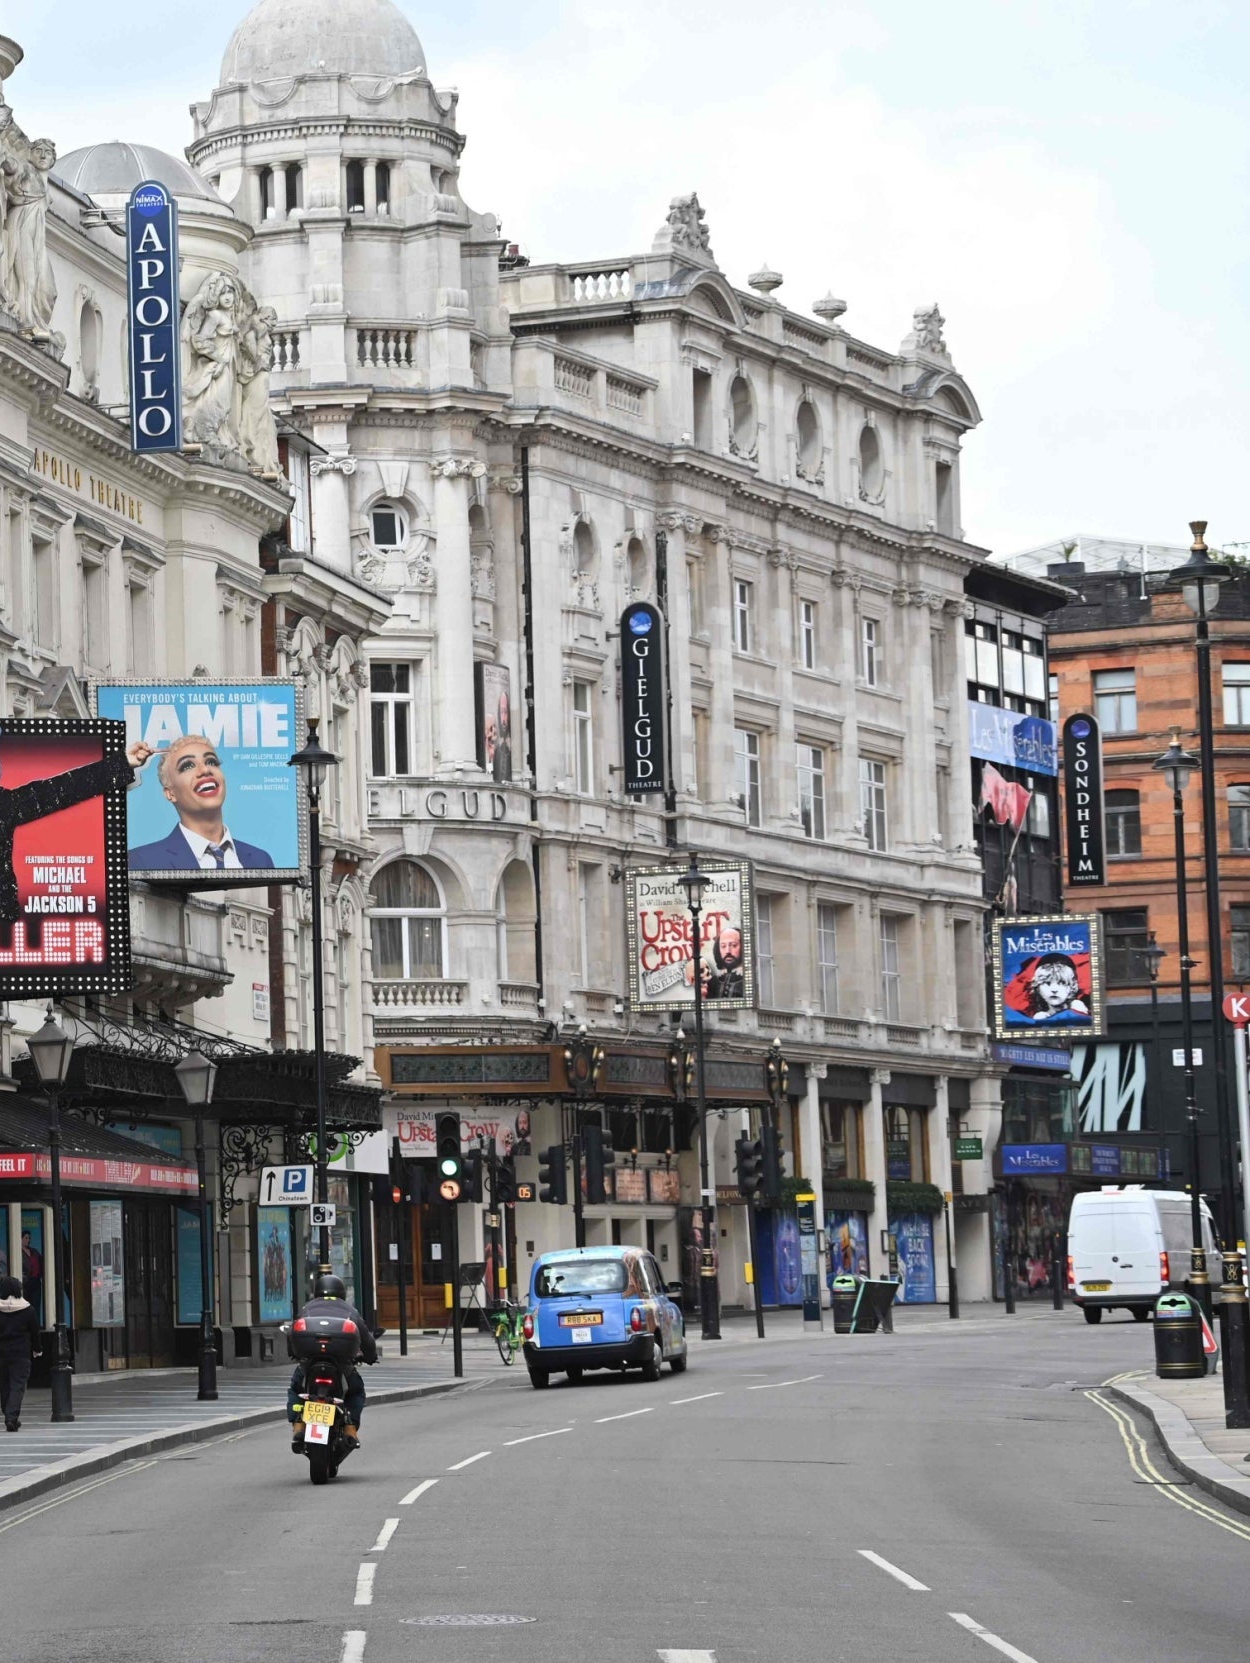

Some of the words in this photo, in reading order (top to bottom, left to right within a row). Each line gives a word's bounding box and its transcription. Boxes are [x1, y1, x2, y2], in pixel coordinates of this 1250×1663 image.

[136, 194, 163, 203] NIMAX
[136, 223, 172, 437] APOLLO
[34, 448, 81, 492] APOLLO
[90, 476, 142, 524] THEATRE
[123, 693, 185, 704] EVERYBODY'S
[187, 693, 225, 703] TALKING
[228, 692, 258, 703] ABOUT
[632, 638, 654, 778] GIELGUD
[972, 709, 992, 753] Les
[628, 781, 662, 789] THEATRE
[367, 790, 507, 820] ELGUD
[1074, 741, 1093, 871] SONDHEIM
[26, 856, 54, 864] FEATURING
[56, 856, 66, 864] THE
[67, 856, 86, 864] SONGS
[87, 856, 94, 864] OF
[33, 866, 86, 884] MICHAEL
[640, 881, 675, 896] David
[24, 896, 84, 913] JACKSON
[88, 896, 96, 913] 5
[1034, 928, 1053, 941] Les
[1006, 934, 1084, 954] Misérables
[1231, 998, 1250, 1018] K
[397, 1112, 420, 1121] David
[18, 1158, 26, 1171] IT
[288, 1171, 302, 1190] P
[519, 1188, 530, 1198] 05
[308, 1404, 330, 1414] EG19
[309, 1413, 329, 1424] XCE
[310, 1424, 322, 1438] L
